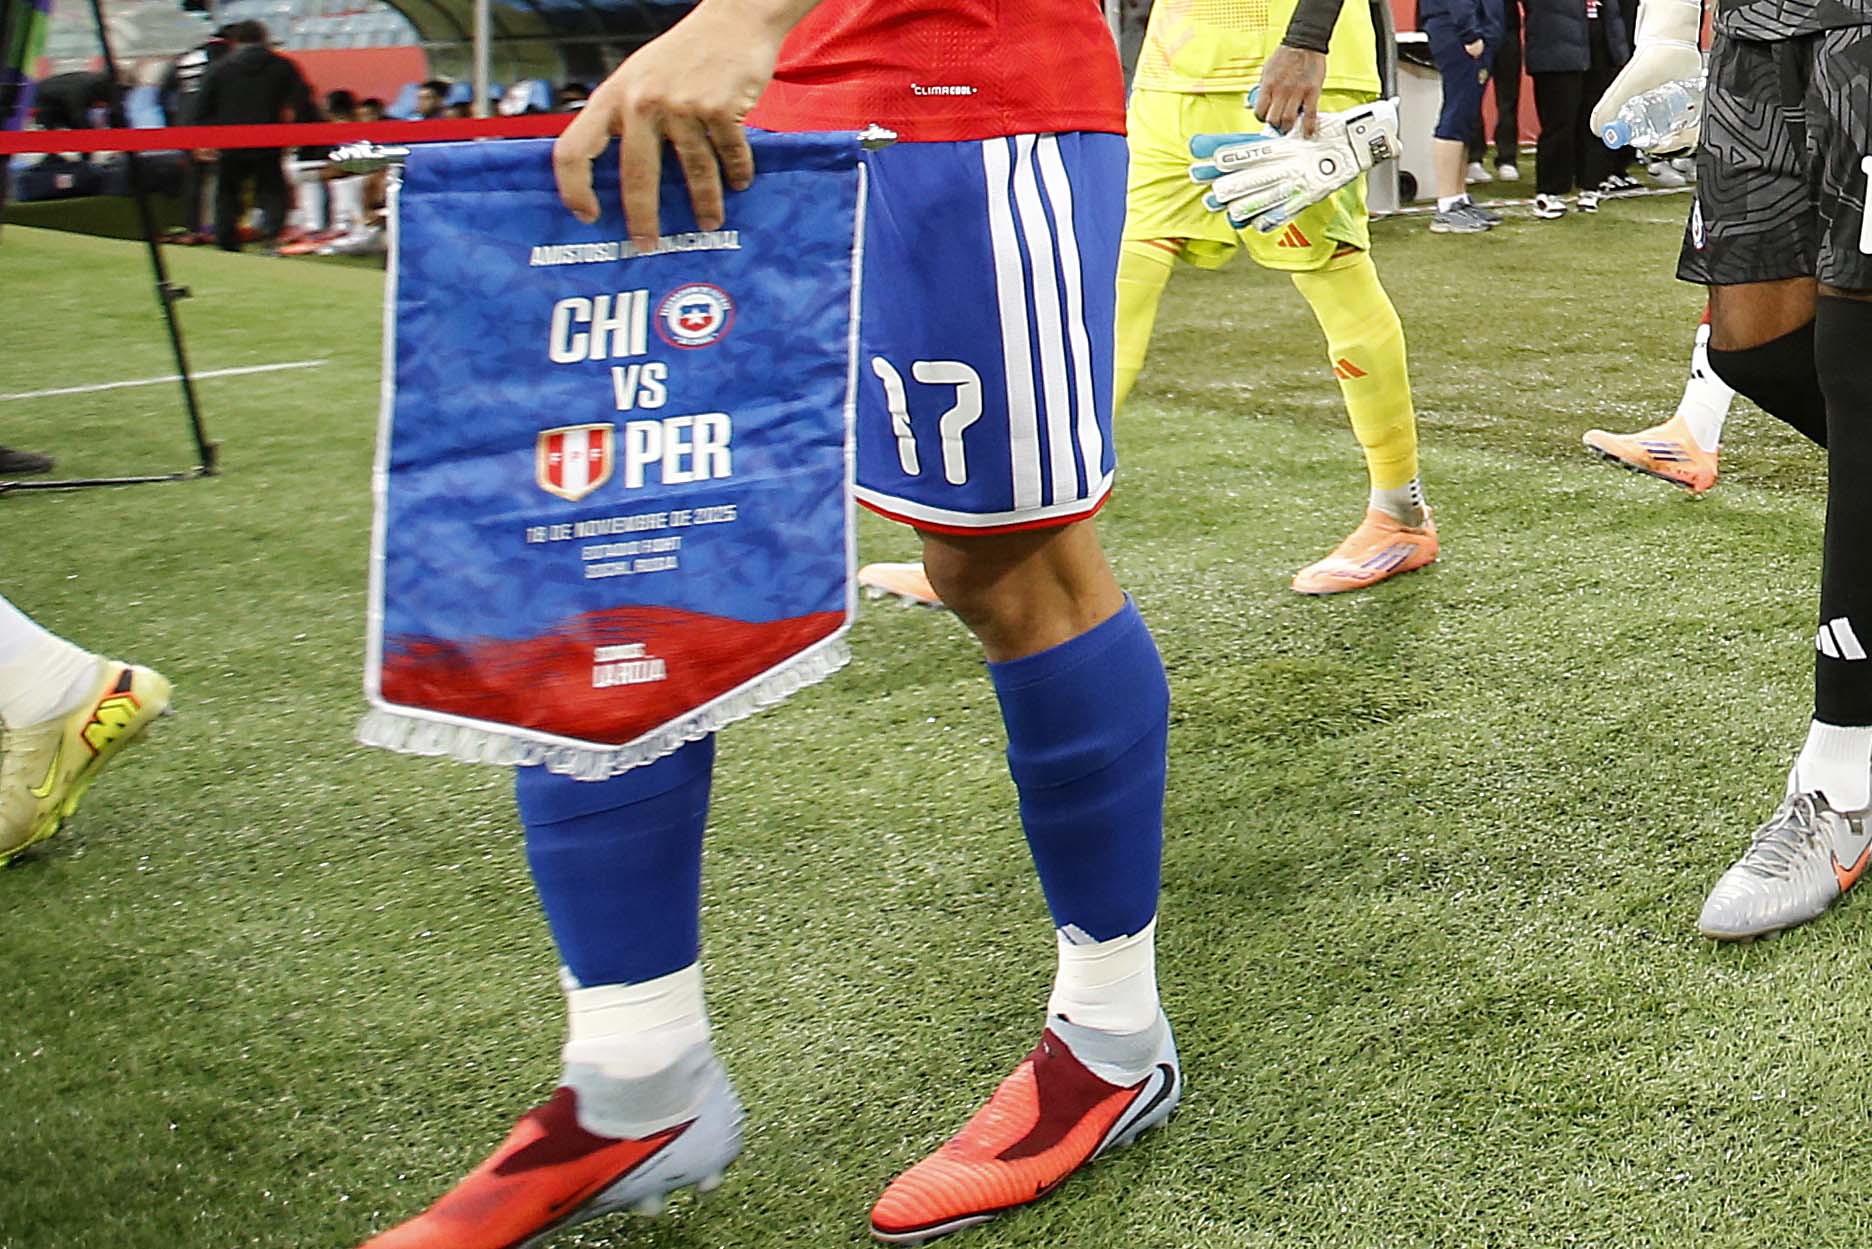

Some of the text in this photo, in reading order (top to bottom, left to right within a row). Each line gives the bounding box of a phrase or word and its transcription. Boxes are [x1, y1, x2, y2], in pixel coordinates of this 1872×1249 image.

[1222, 145, 1273, 163] ELITE
[549, 289, 649, 364] CHI
[611, 362, 668, 411] VS
[624, 413, 733, 489] PER
[872, 356, 983, 486] 17
[548, 523, 573, 541] DE
[669, 508, 693, 527] DE
